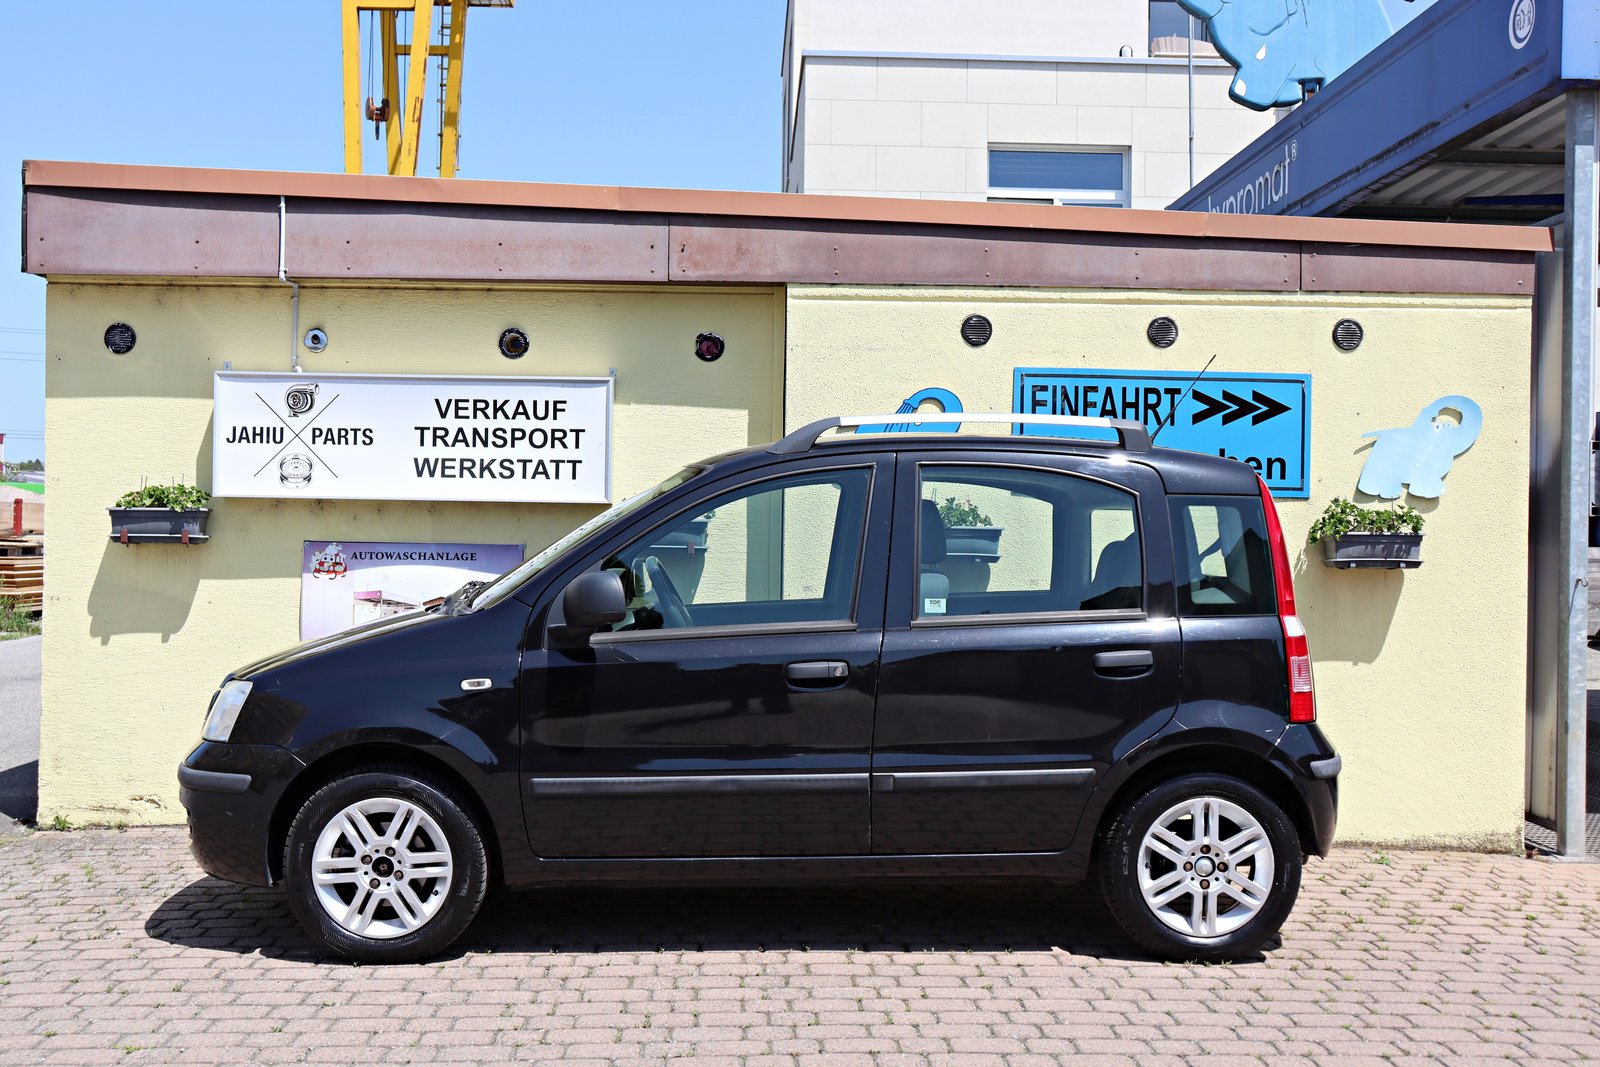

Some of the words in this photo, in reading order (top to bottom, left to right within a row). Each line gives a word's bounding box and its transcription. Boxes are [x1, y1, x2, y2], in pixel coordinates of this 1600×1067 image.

[434, 398, 568, 421] VERKAUF
[1031, 384, 1182, 427] EINFAHRT
[226, 426, 284, 444] JAHIU
[311, 427, 374, 446] PARTS
[414, 426, 586, 450] TRANSPORT
[413, 457, 583, 480] WERKSTATT
[350, 551, 477, 561] AUTOWASCHANLAGE
